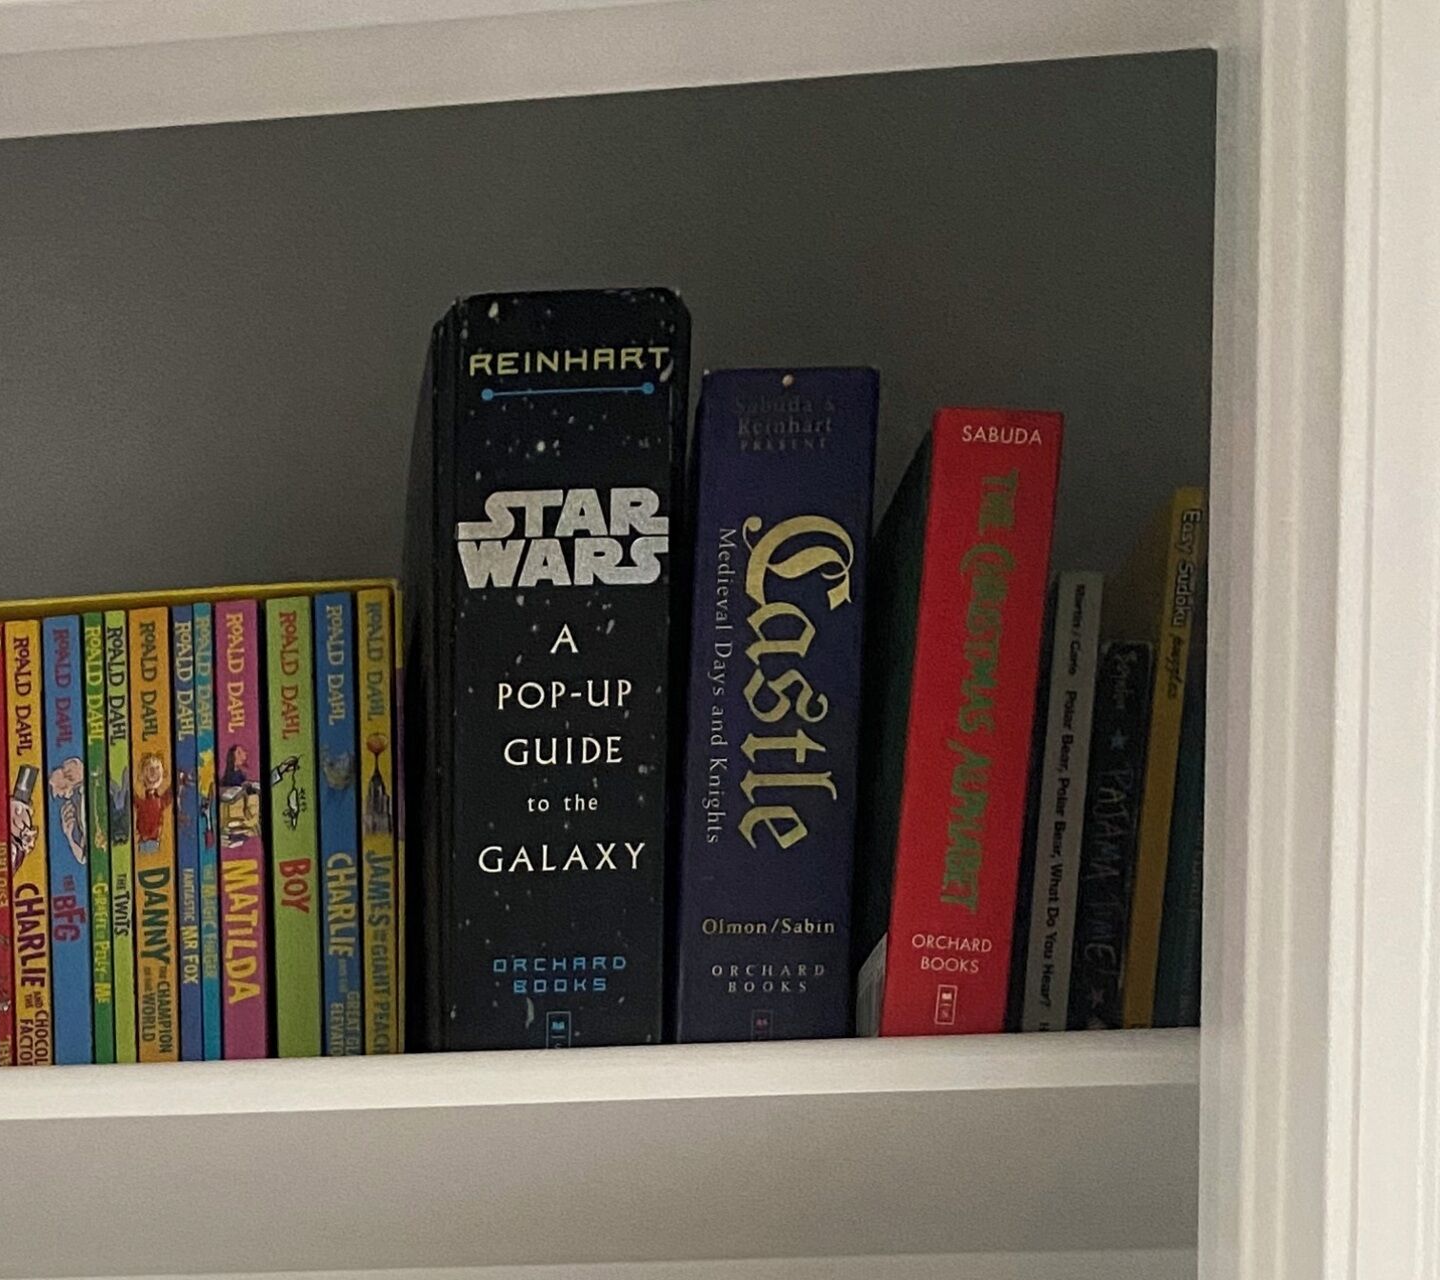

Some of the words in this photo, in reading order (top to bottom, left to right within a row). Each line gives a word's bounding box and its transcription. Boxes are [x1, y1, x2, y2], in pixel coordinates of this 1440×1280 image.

[469, 347, 669, 376] REINHART
[961, 425, 1042, 445] SABUDA
[457, 488, 669, 540] STAR
[1181, 508, 1201, 558] Easy
[458, 536, 669, 589] WARS
[715, 528, 736, 629] Medieval
[1172, 562, 1194, 627] Sudoku
[226, 612, 244, 673] ROALD
[550, 623, 579, 653] A
[14, 636, 32, 696] ROALD
[708, 642, 733, 696] Days
[738, 515, 854, 849] Castle
[227, 681, 244, 733] DAHL
[497, 680, 632, 710] POP-UP
[16, 706, 32, 756] DAHL
[504, 737, 622, 765] GUIDE
[710, 706, 728, 746] and
[528, 797, 549, 812] to
[563, 794, 598, 811] the
[701, 757, 727, 844] Knights
[478, 843, 645, 872] GALAXY
[279, 858, 311, 913] BOY
[327, 853, 358, 957] CHARLIE
[14, 883, 46, 988] CHARLIE
[53, 895, 85, 943] BFG
[137, 867, 170, 963] DANNY
[223, 858, 260, 1004] MATILDA
[493, 956, 626, 972] ORCHARD
[912, 934, 992, 952] ORCHARD
[921, 956, 979, 974] BOOKS
[513, 979, 607, 993] BOOKS
